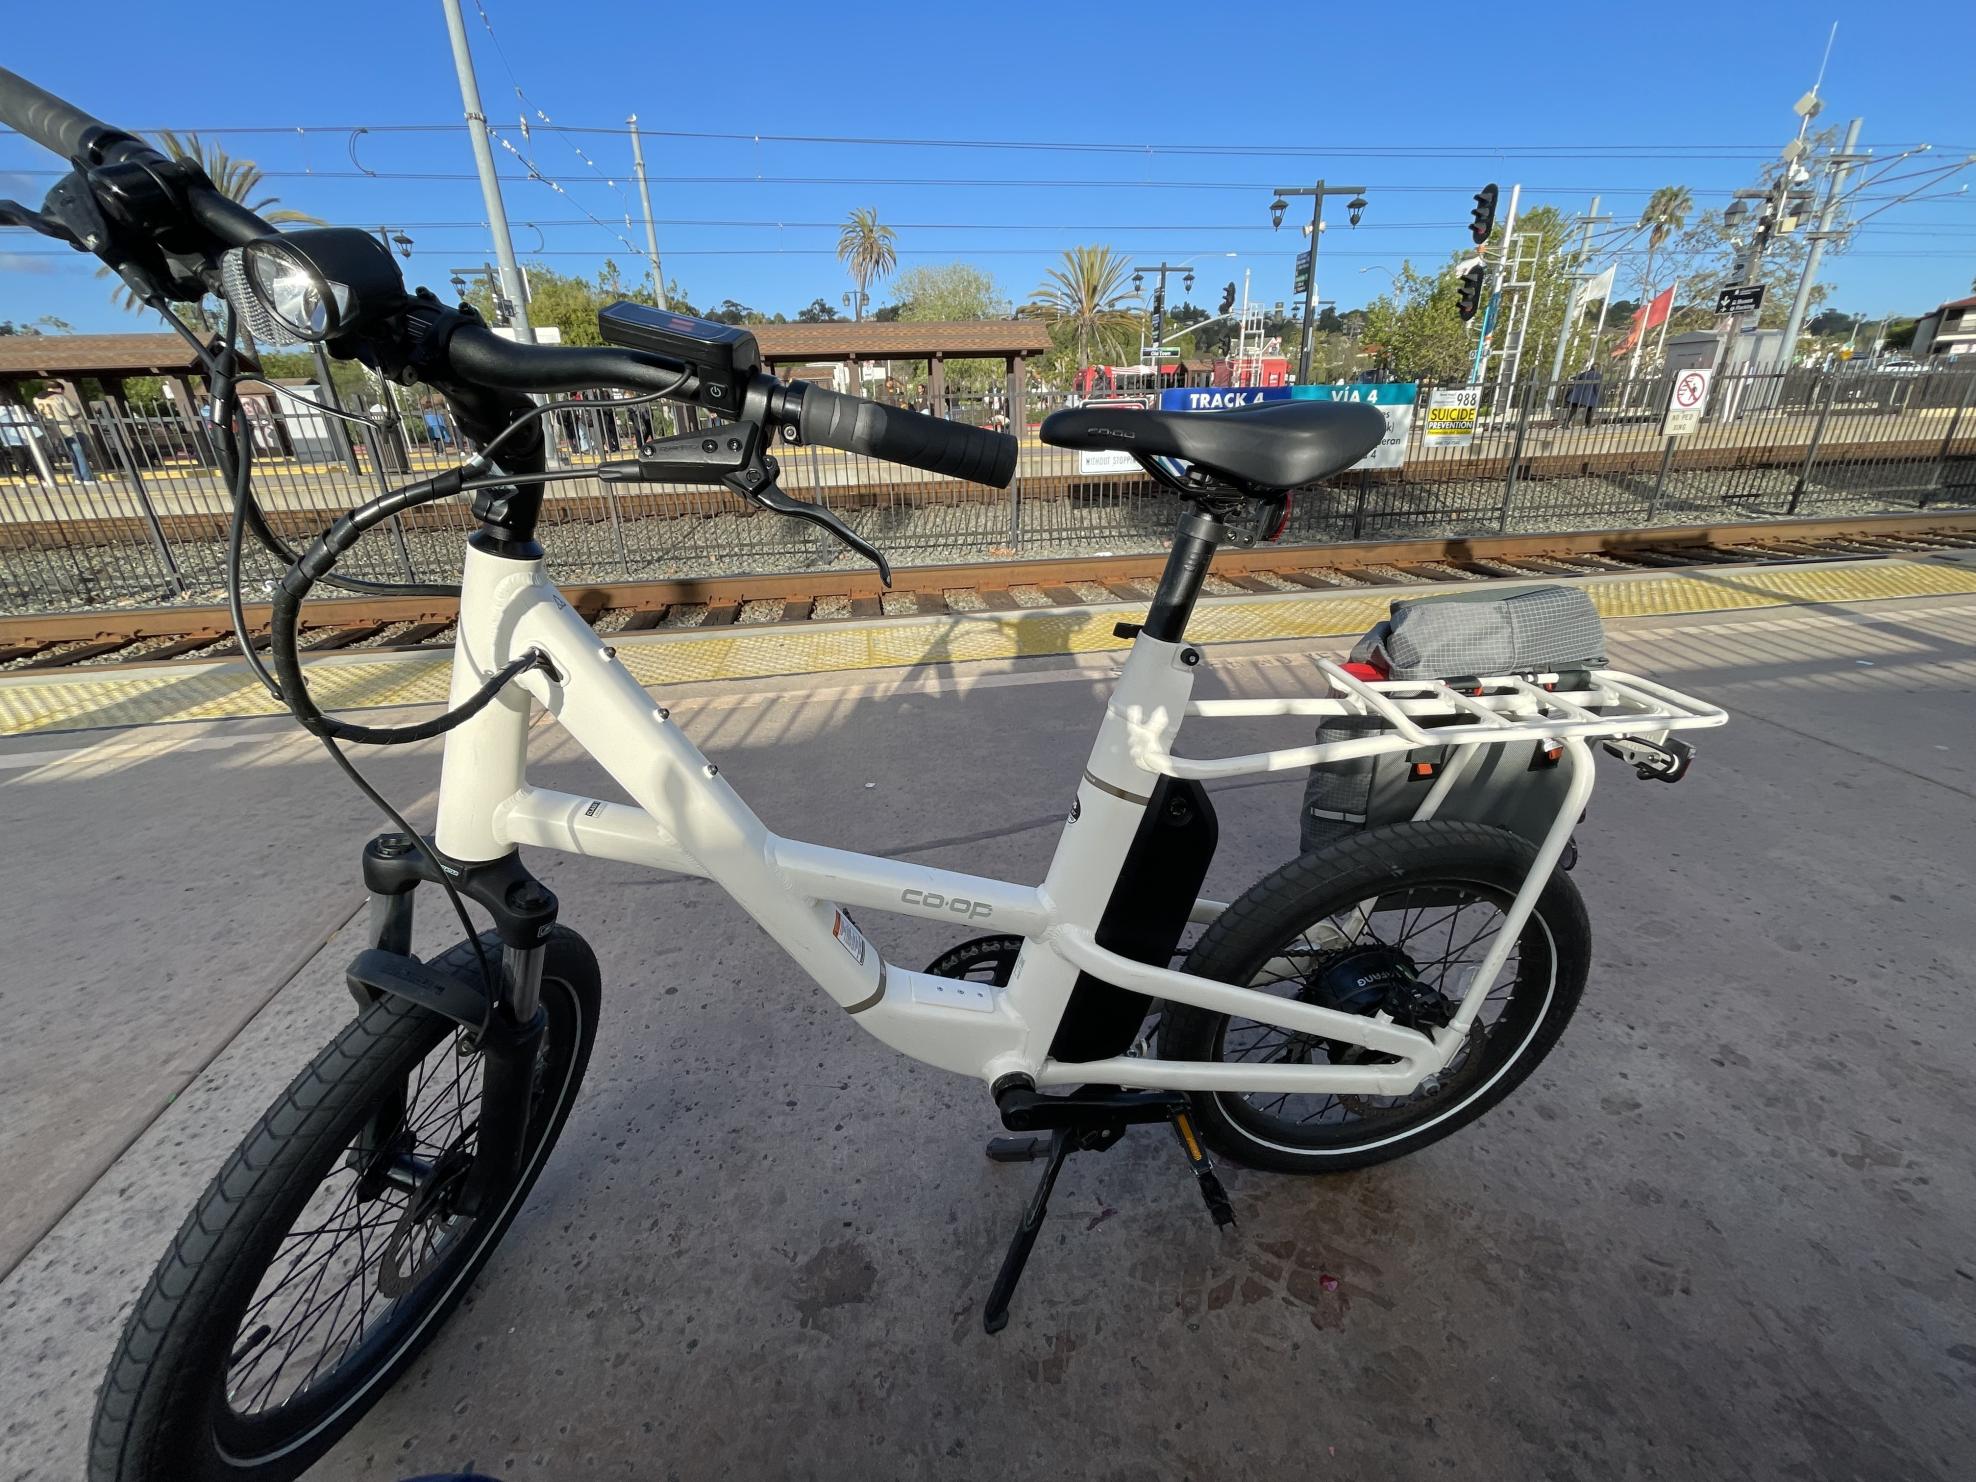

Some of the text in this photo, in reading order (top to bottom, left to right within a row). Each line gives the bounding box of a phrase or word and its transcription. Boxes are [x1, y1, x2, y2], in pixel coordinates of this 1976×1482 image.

[1190, 392, 1264, 408] TRACK 4
[1331, 386, 1378, 404] VÍA 4
[1456, 393, 1477, 406] 988
[1430, 408, 1476, 421] SUICIDE
[1428, 421, 1474, 430] PREVENTION
[1085, 456, 1110, 465] WITHOUT
